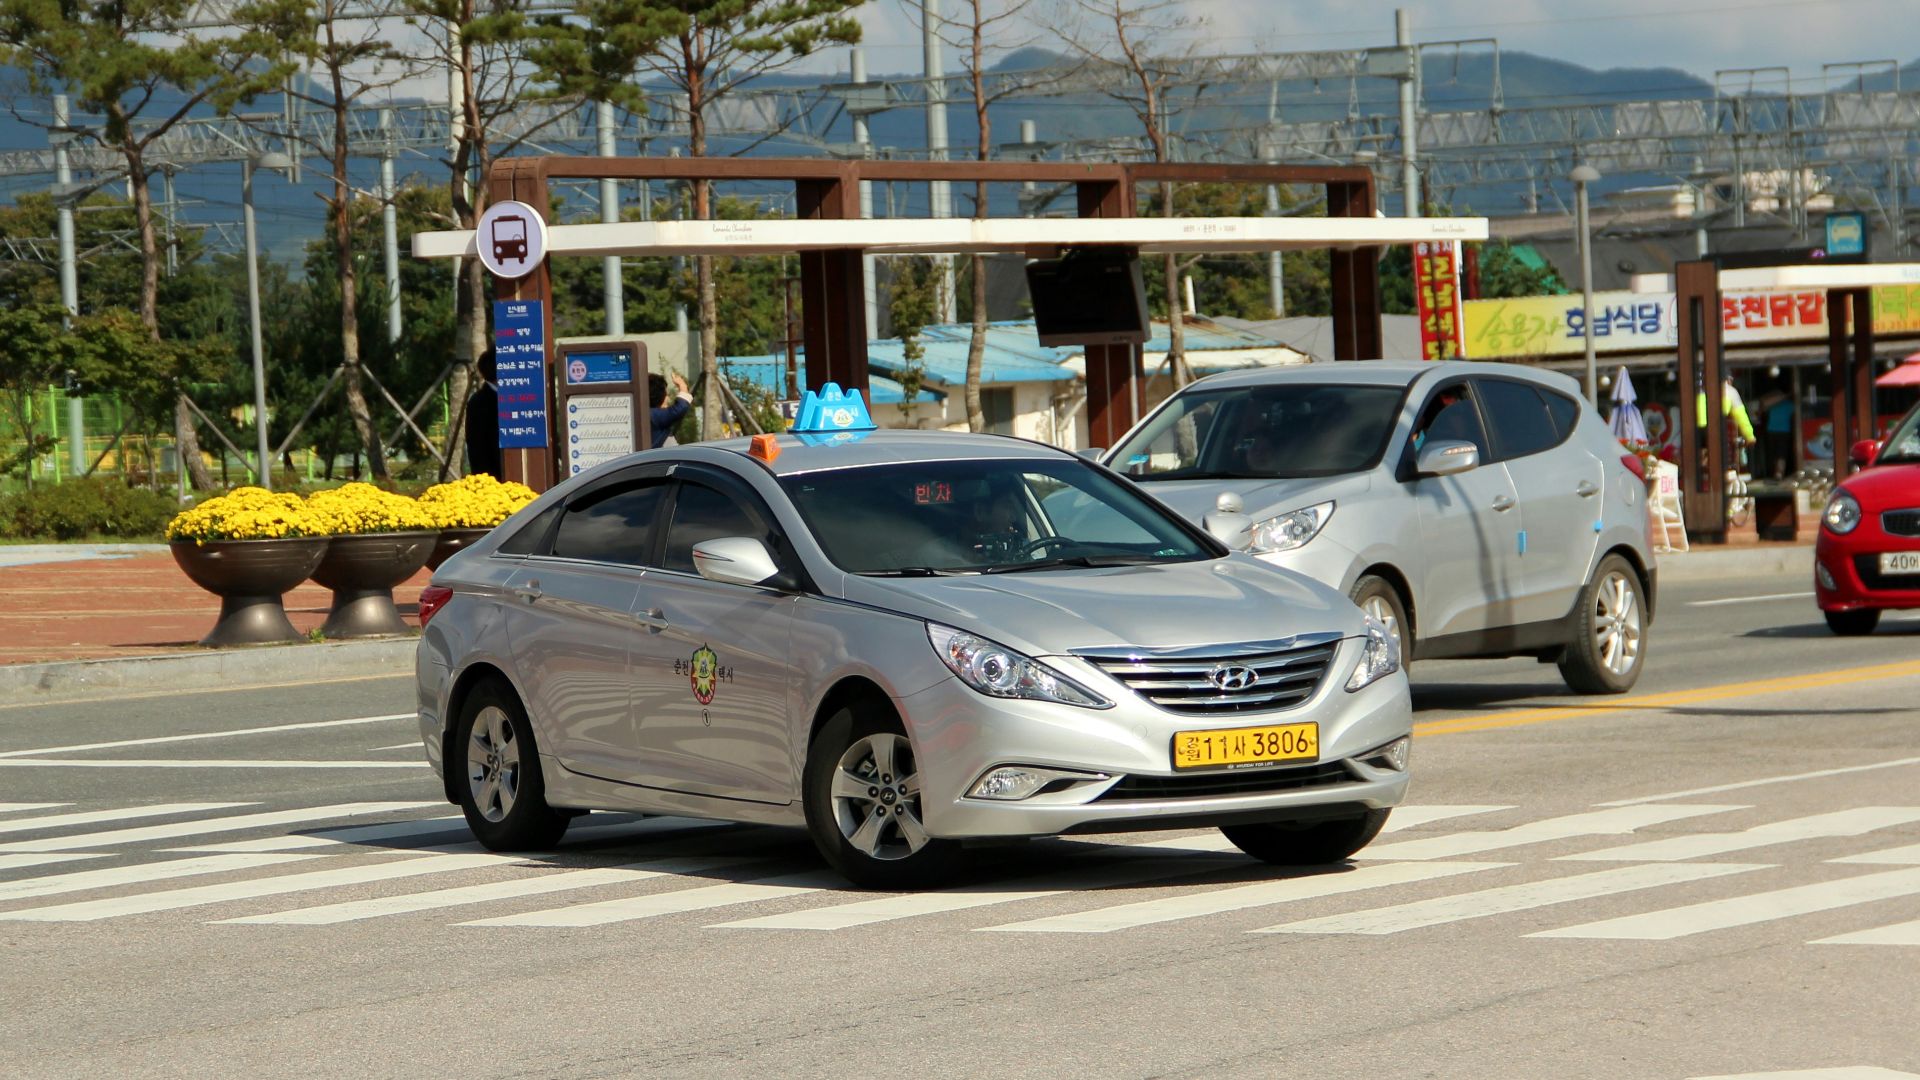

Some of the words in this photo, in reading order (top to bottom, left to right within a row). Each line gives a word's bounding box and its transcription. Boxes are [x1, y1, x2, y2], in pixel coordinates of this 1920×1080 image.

[507, 305, 527, 314] 안내문
[1566, 302, 1663, 339] 호남식당
[1722, 291, 1852, 331] 춘천닭갈
[1186, 737, 1200, 761] 강원
[1252, 730, 1309, 757] 3806
